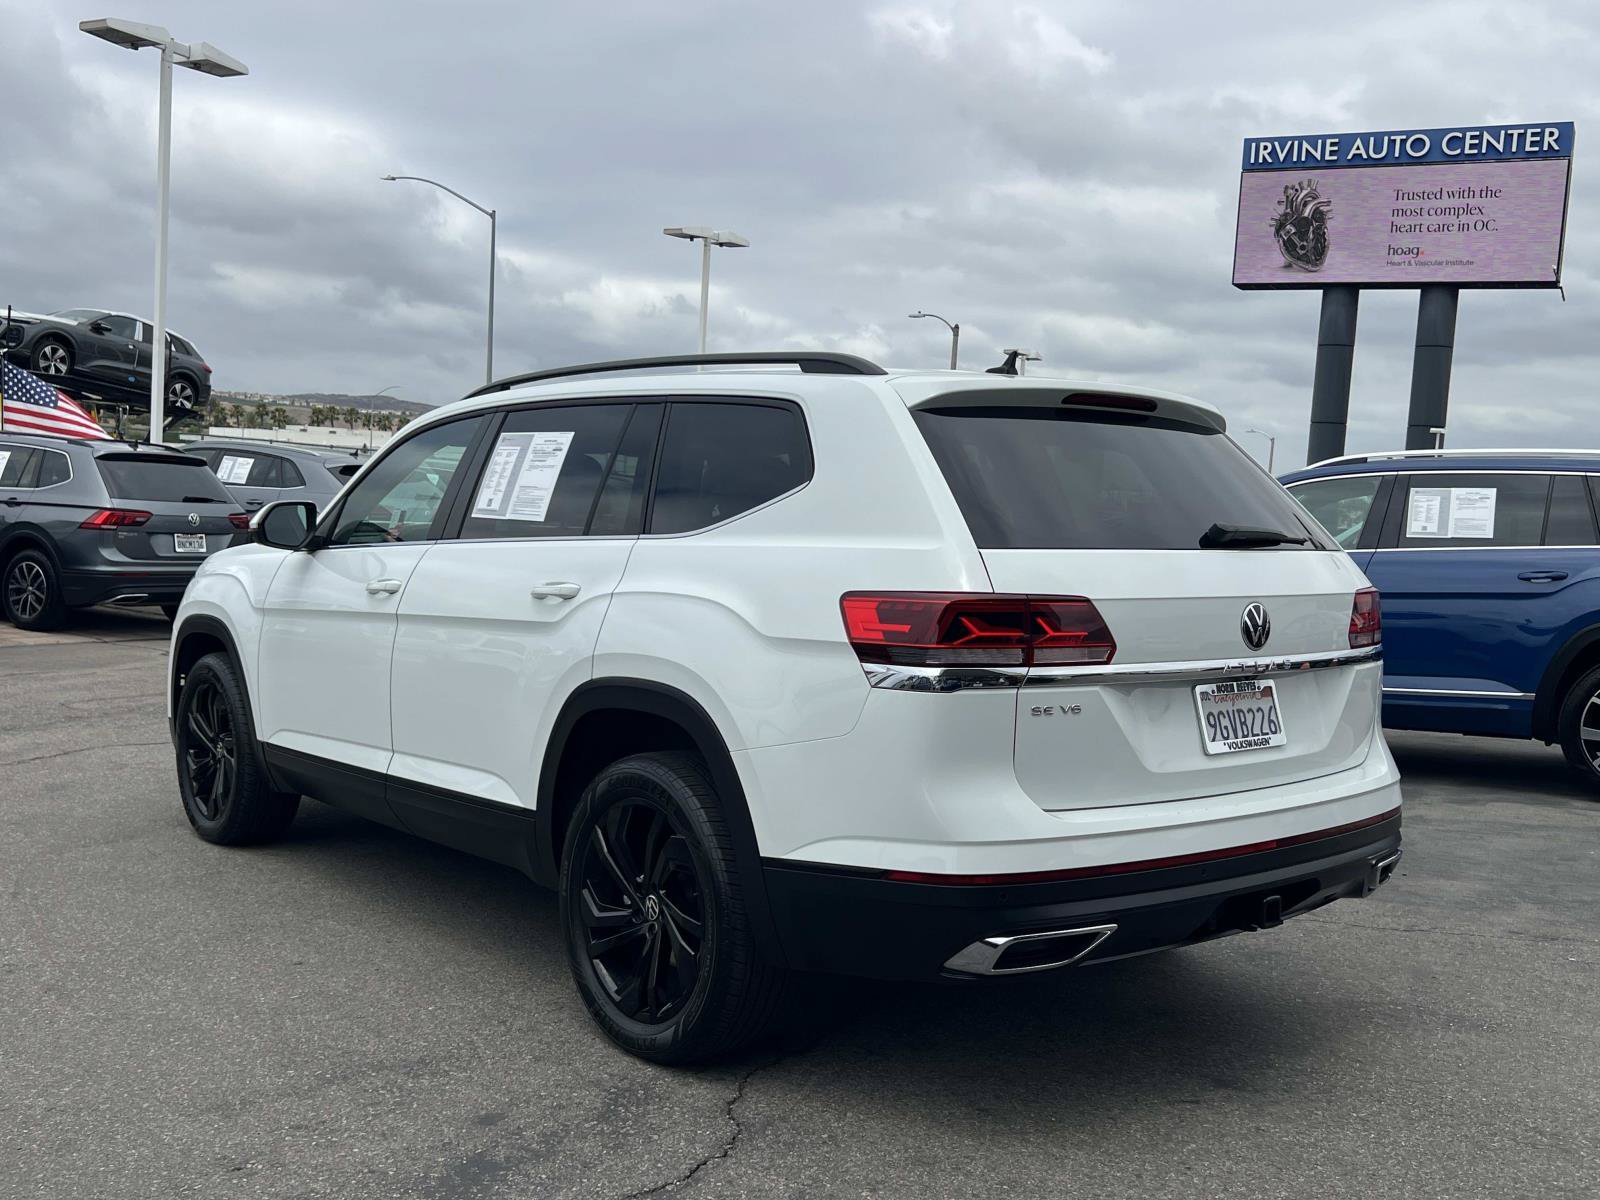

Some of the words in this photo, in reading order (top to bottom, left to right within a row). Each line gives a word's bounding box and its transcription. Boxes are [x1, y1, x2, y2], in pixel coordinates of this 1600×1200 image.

[1249, 138, 1340, 164] IRVINE
[1346, 133, 1431, 161] AUTO
[1441, 127, 1561, 156] CENTER
[1394, 187, 1443, 201] Trusted
[1446, 186, 1476, 200] with
[1479, 185, 1502, 199] the
[1391, 206, 1425, 218] most
[1427, 203, 1484, 219] complex
[1390, 221, 1424, 233] heart
[1426, 222, 1455, 233] care
[1457, 220, 1470, 232] in
[1473, 219, 1499, 232] OC.
[1414, 259, 1444, 267] Vascular
[1223, 659, 1292, 674] ATLAS
[1031, 705, 1055, 717] SE
[1059, 703, 1082, 715] V6
[1206, 705, 1278, 742] 9GVB226
